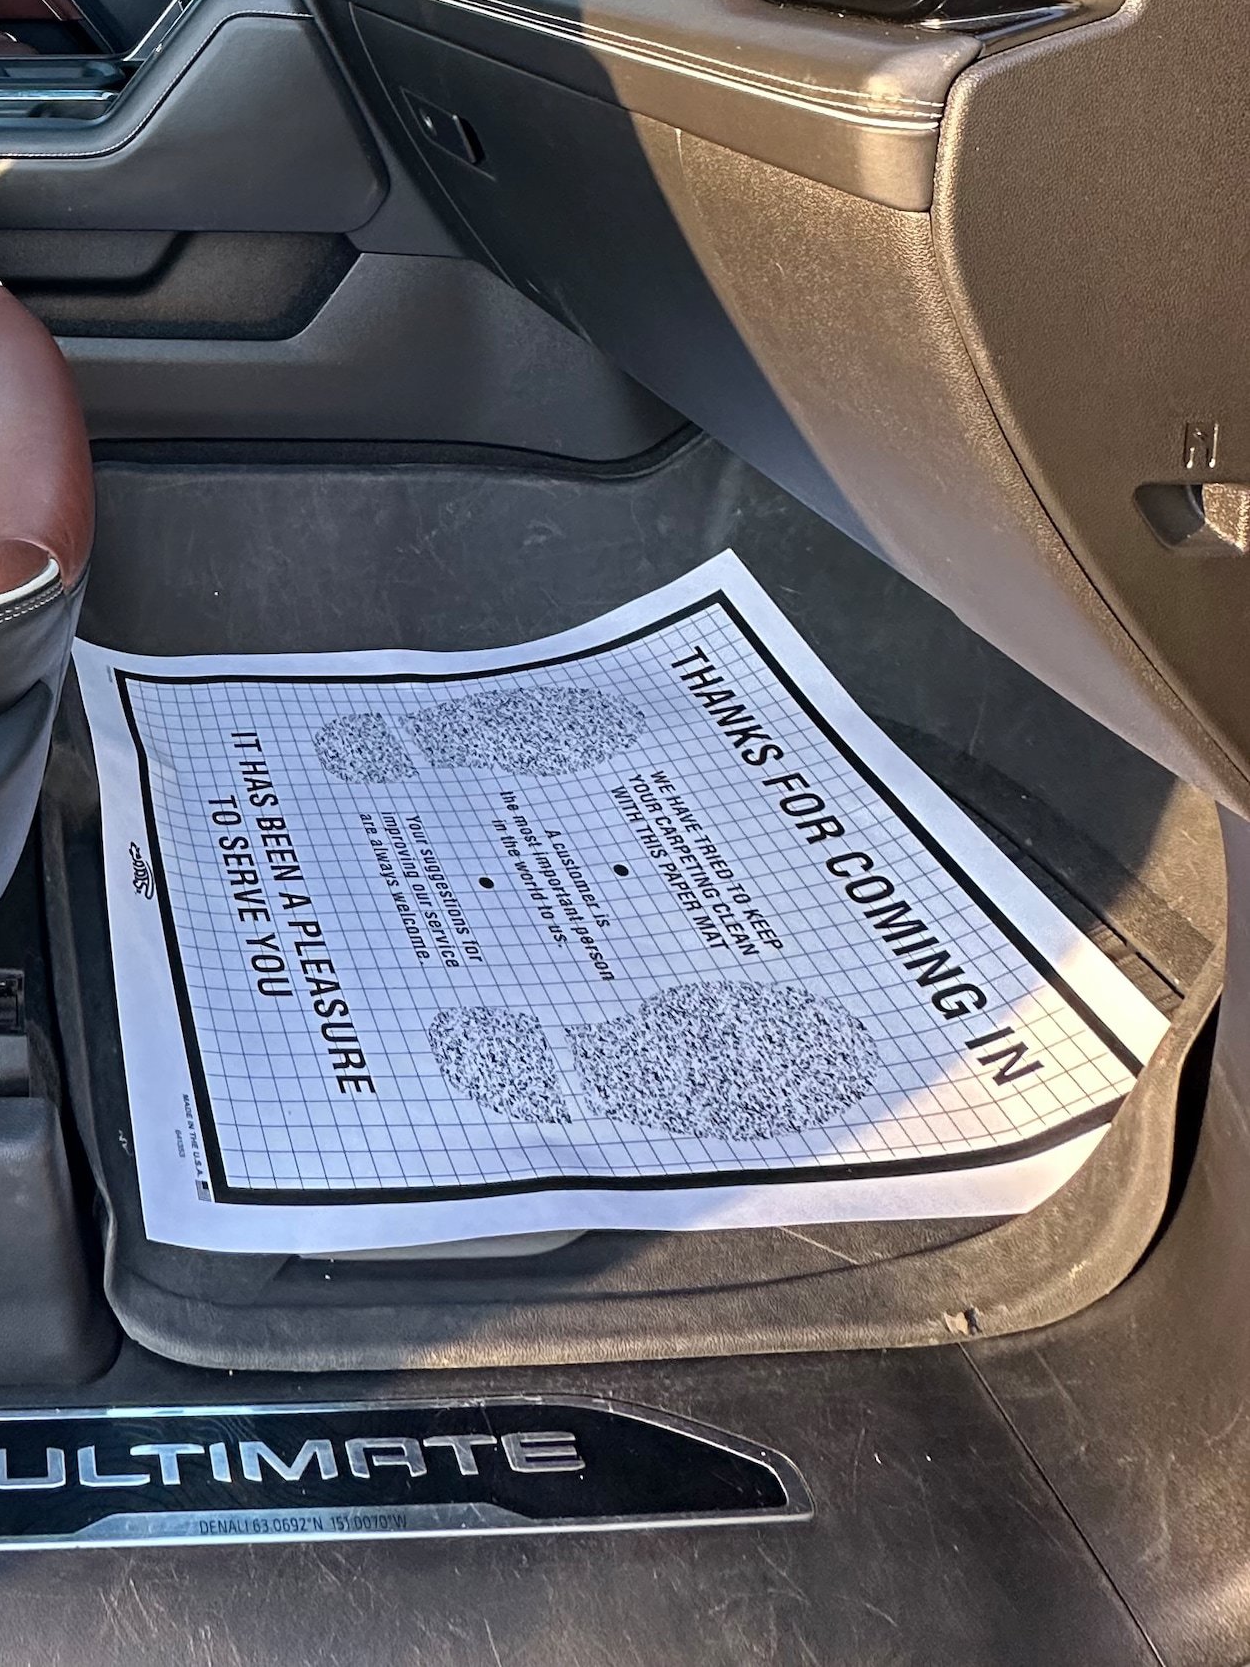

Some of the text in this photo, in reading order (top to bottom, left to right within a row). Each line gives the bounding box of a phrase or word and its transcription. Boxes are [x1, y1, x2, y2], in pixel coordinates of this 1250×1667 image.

[208, 795, 293, 997] TO SERVE YOU
[231, 732, 376, 1094] IT HAS BEEN A PLEASURE
[360, 813, 430, 966] are always welcome.
[381, 811, 459, 967] improving our service
[405, 815, 482, 962] Your suggestions for
[492, 819, 567, 948] in the world to us.
[500, 790, 614, 981] the most important person
[545, 829, 610, 928] A customer is
[611, 785, 730, 950] WITH THIS PAPER MAT
[628, 773, 760, 956] YOUR CARPETING CLEAN
[650, 770, 784, 950] WE HAVE TRIED TO KEEP
[671, 645, 1045, 1086] THANKS FOR COMING IN
[182, 1093, 193, 1119] MADE
[187, 1120, 194, 1129] IN
[189, 1131, 198, 1149] THE
[200, 1519, 248, 1534] DENALI
